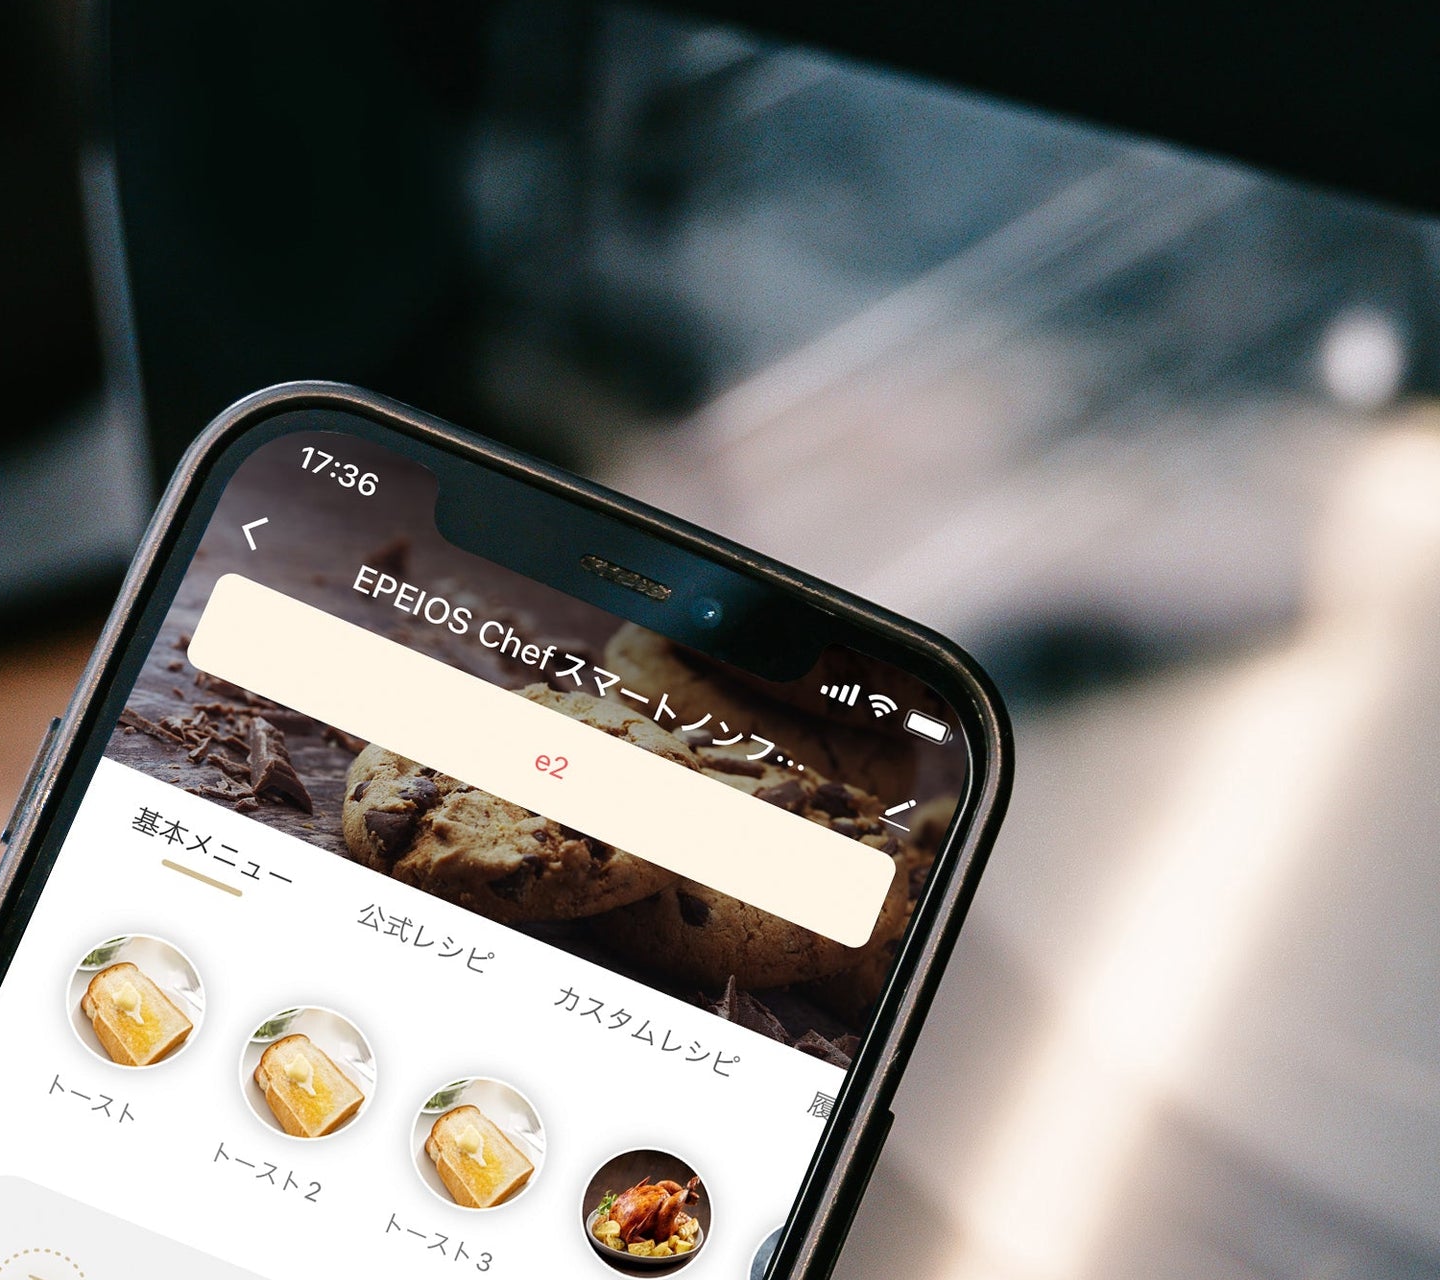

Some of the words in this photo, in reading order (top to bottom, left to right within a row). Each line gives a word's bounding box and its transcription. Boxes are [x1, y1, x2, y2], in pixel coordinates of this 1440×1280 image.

[301, 446, 379, 496] 17:36
[352, 564, 472, 635] EPEIOS
[479, 620, 558, 670] Chef
[534, 751, 570, 781] e2
[131, 806, 293, 884] 基本メニュー
[356, 903, 496, 974] 公式レシピ
[553, 986, 741, 1078] カスタムレシピ
[48, 1073, 135, 1124] トースト
